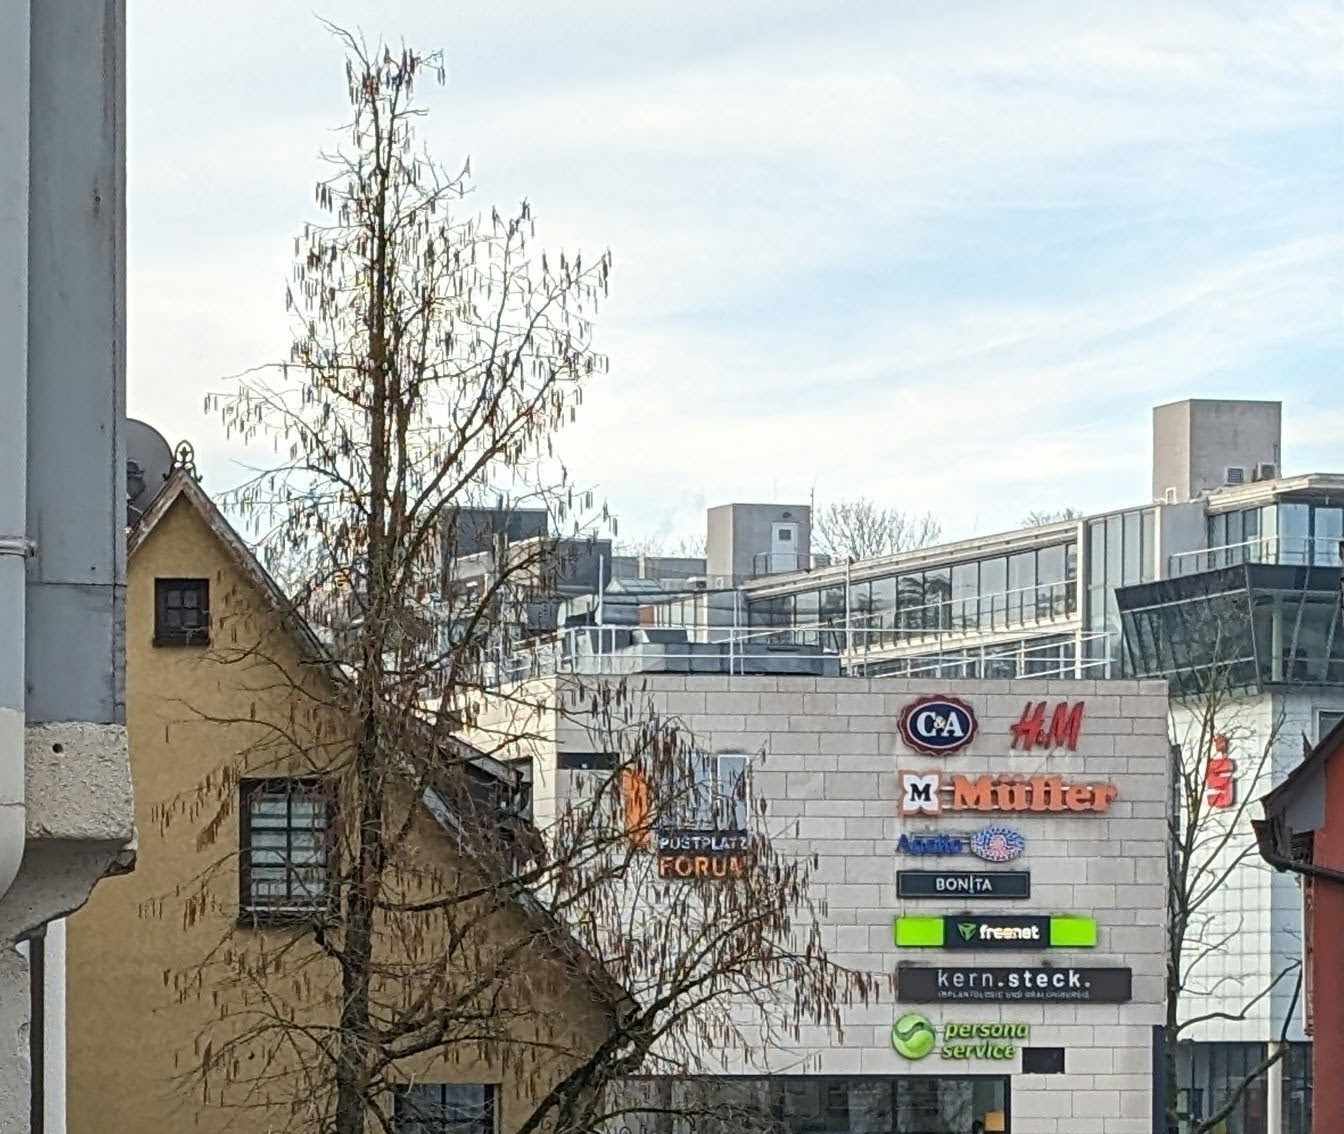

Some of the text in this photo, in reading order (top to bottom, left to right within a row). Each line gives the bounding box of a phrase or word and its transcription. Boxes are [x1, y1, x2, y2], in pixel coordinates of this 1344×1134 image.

[916, 710, 964, 738] C&A
[1010, 700, 1085, 751] H&M
[951, 774, 1119, 813] Müller
[935, 876, 993, 894] BONITA
[979, 924, 1040, 940] freenet
[943, 1021, 1030, 1041] persona
[941, 1041, 1016, 1060] service
